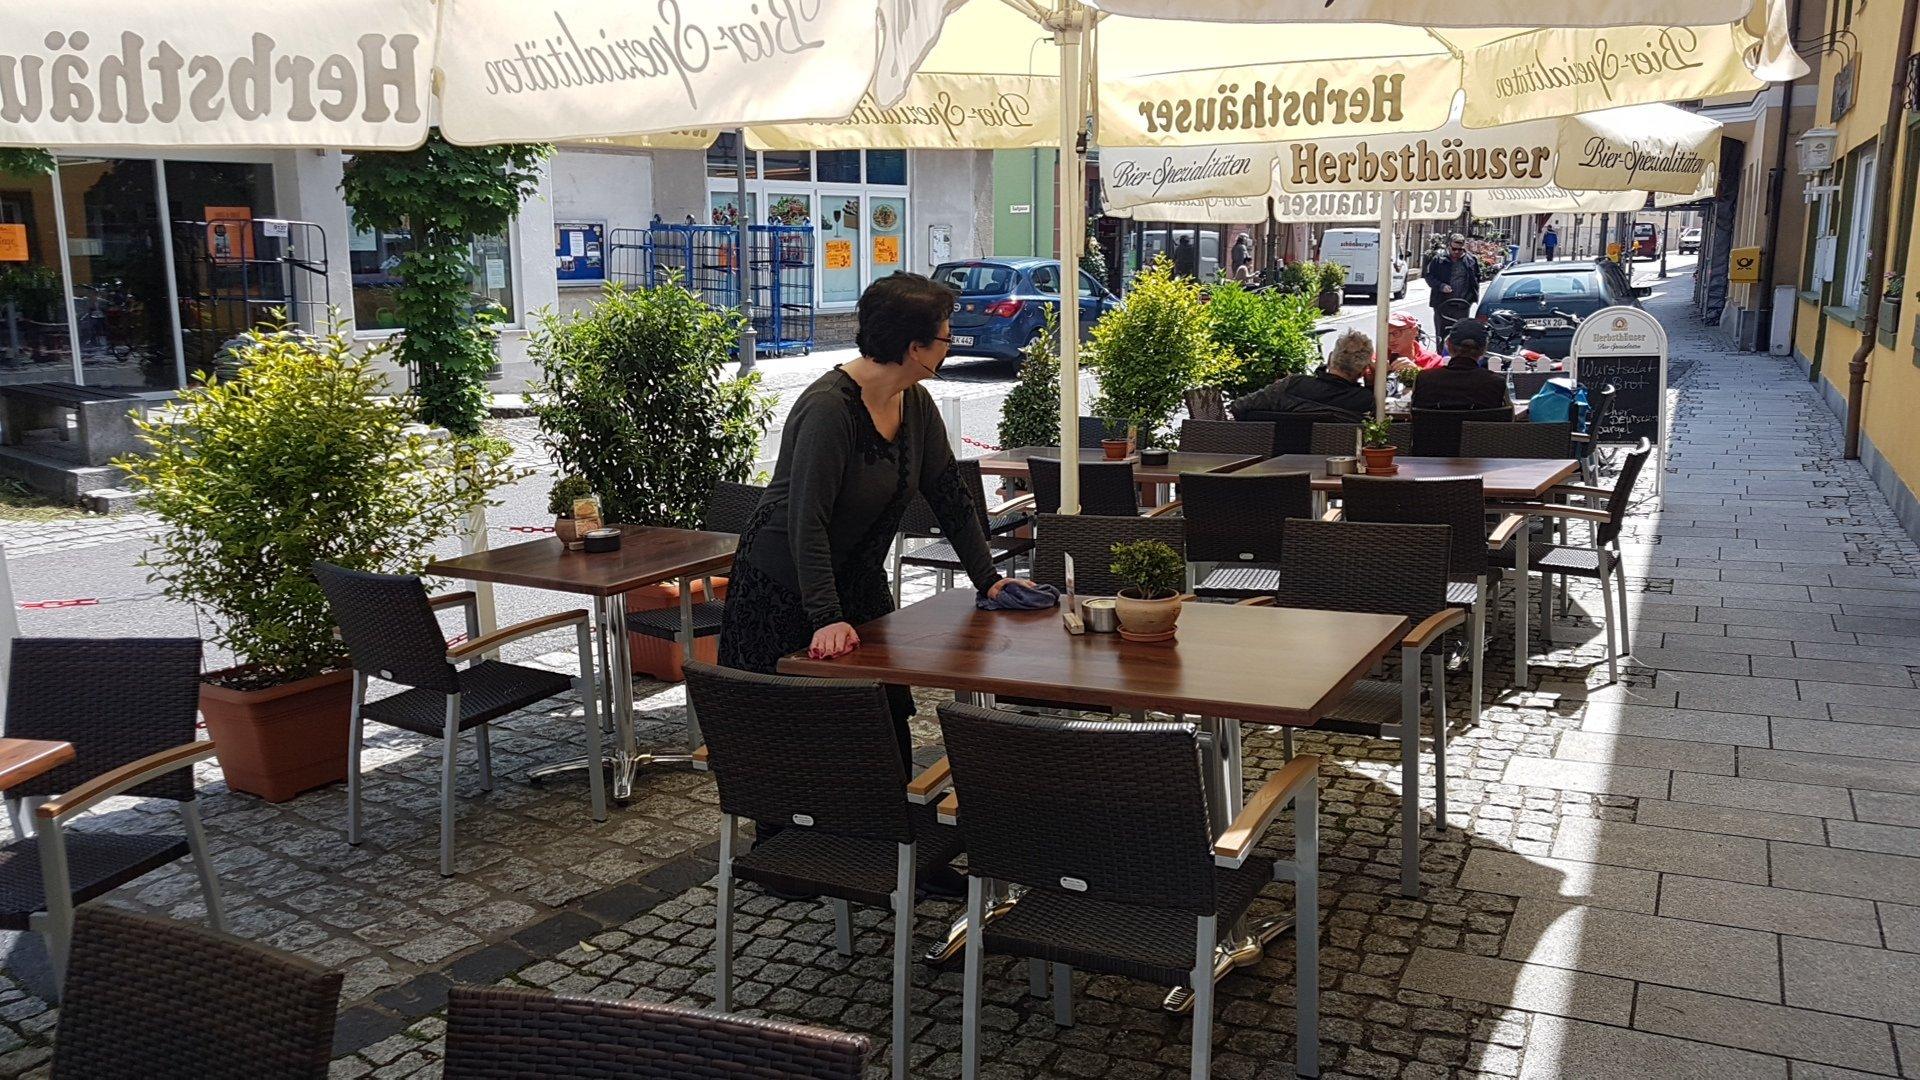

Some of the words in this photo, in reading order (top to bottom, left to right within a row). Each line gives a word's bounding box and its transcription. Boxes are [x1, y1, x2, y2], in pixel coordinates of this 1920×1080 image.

[1112, 148, 1250, 197] Bier-Spezialitäten
[1290, 138, 1550, 184] Herbsthäuser
[1578, 136, 1705, 185] Bier-Spezialitäten
